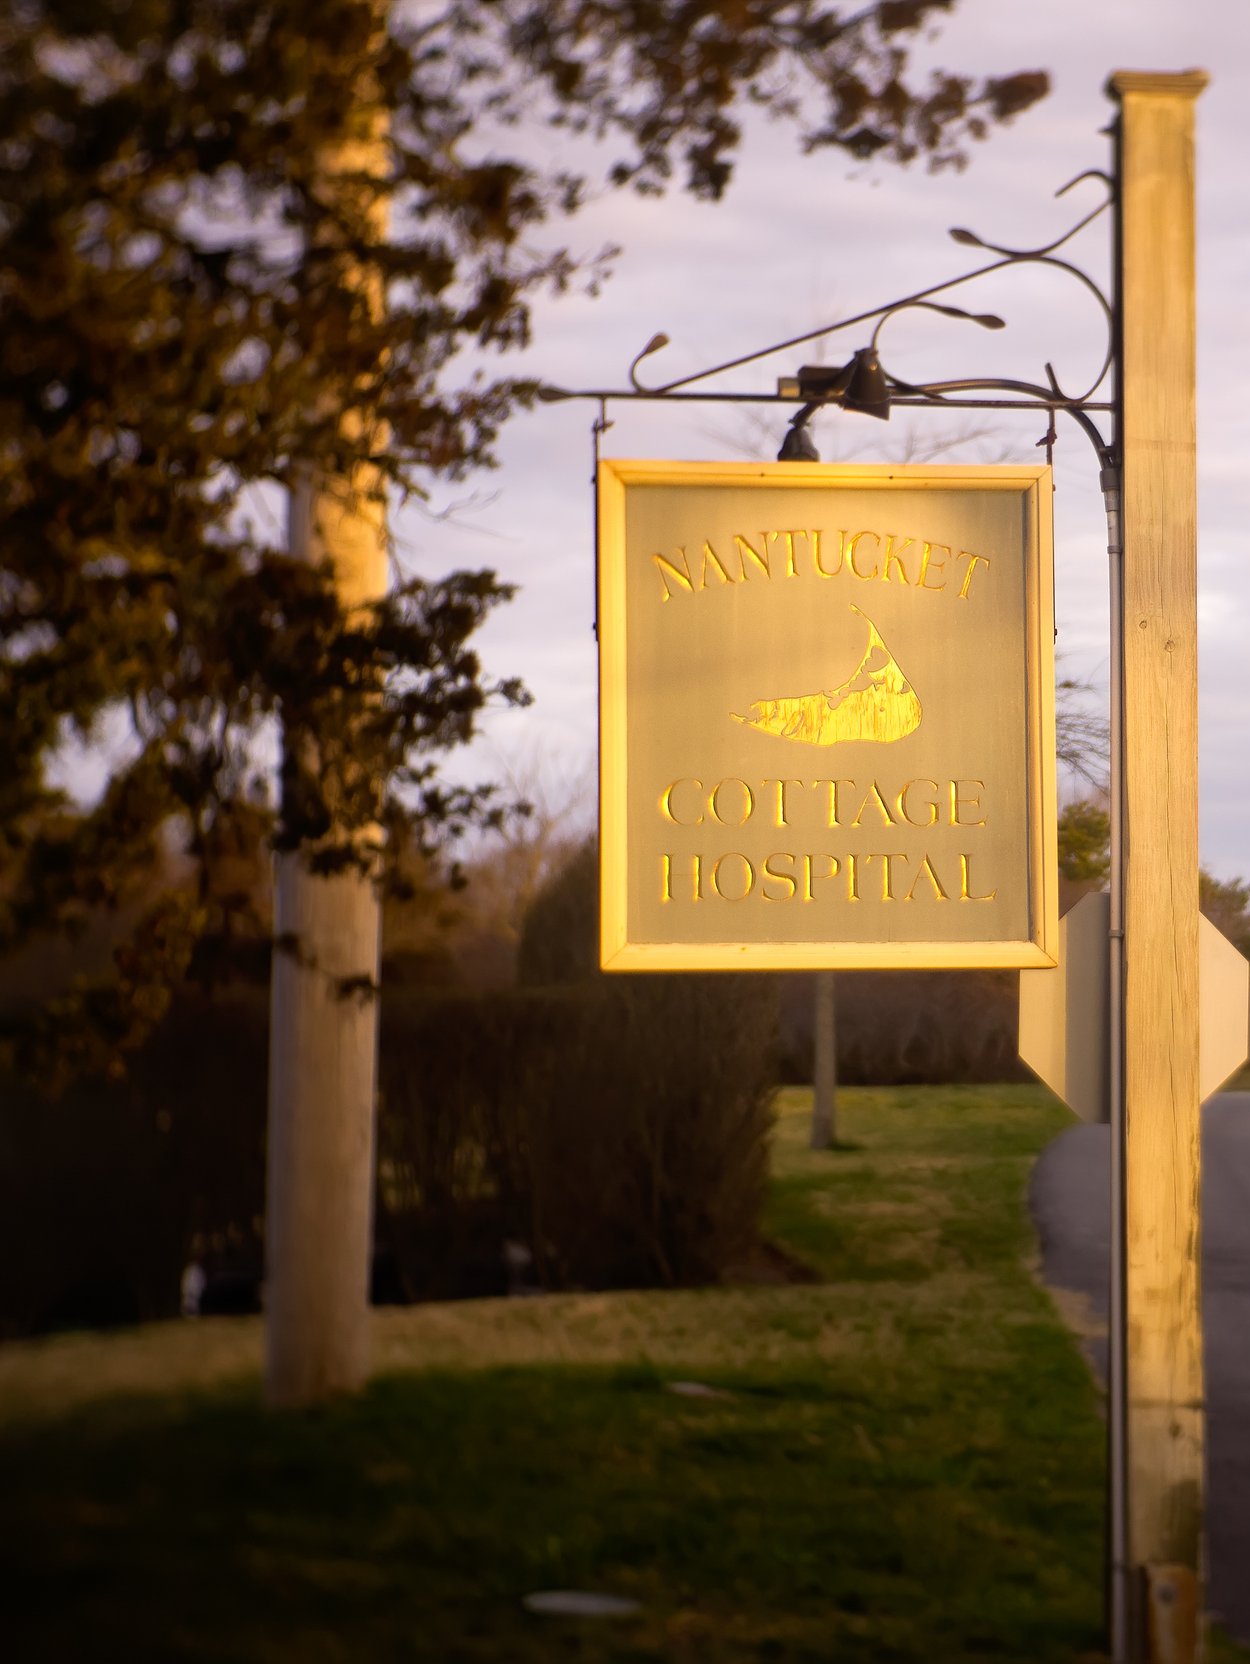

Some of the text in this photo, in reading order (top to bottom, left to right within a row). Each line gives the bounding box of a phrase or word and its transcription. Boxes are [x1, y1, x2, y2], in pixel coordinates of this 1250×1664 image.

[653, 530, 991, 602] NANTUCKET
[659, 778, 986, 826] COTTAGE
[660, 852, 997, 902] HOSPITAL
